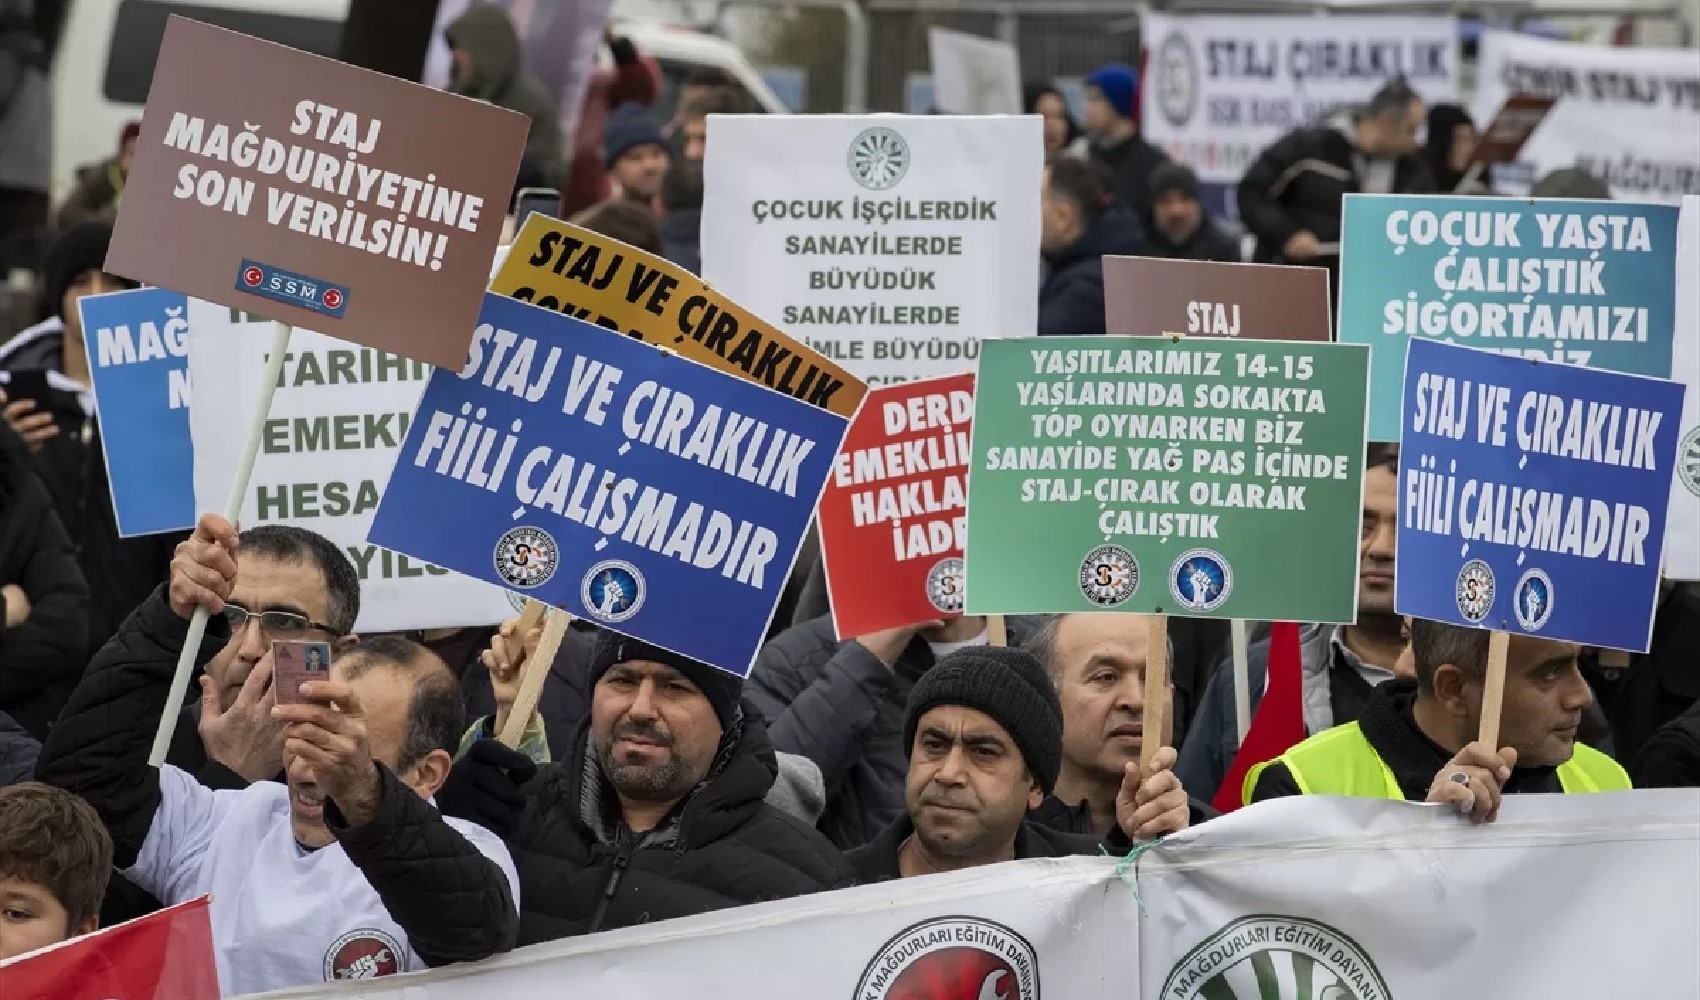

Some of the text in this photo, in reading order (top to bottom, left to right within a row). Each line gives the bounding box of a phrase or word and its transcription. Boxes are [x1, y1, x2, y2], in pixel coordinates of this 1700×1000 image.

[290, 99, 382, 154] STAJ
[163, 112, 484, 232] MAĞDURİYETİNE
[173, 163, 449, 271] SON VERİLSİN!
[752, 195, 998, 225] ÇOCUK İŞÇİLERDİK
[785, 231, 962, 256] SANAYİLERDE
[1386, 210, 1652, 260] ÇOCUK YAŞTA
[809, 266, 936, 290] BÜYÜDÜK
[1434, 257, 1606, 304] ÇALIŞTIK
[528, 231, 624, 290] STAJ
[625, 262, 680, 316] VE
[674, 295, 844, 409] ÇIRAKLIK
[782, 302, 960, 325] SANAYİLERDE
[1186, 301, 1241, 337] STAJ
[1383, 291, 1649, 343] SİGORTAMIZI
[1030, 350, 1314, 381] YAŞITLARIMIZ 14-15
[458, 323, 817, 498] STAJ VE ÇIRAKLIK
[1016, 381, 1325, 413] YAŞLARINDA SOKAKTA
[1413, 372, 1471, 440] STAJ
[1477, 383, 1510, 447] VE
[1516, 391, 1663, 470] ÇIRAKLIK
[1031, 414, 1304, 445] TOP OYNARKEN BİZ
[986, 440, 1348, 484] SANAYİDE YAĞ PAS İÇİNDE
[413, 401, 523, 493] FİİLİ
[512, 445, 779, 590] ÇALIŞMADIR
[1020, 478, 1306, 511] STAJ-ÇIRAK OLARAK
[1405, 454, 1651, 566] FİİLİ ÇALIŞMADIR
[1098, 510, 1219, 543] ÇALIŞTIK
[871, 928, 952, 992] MAĞDURLARI
[955, 925, 1005, 952] EĞİTİM
[1173, 925, 1270, 999] MAĞDURLARI
[1274, 924, 1333, 955] EĞİTİM
